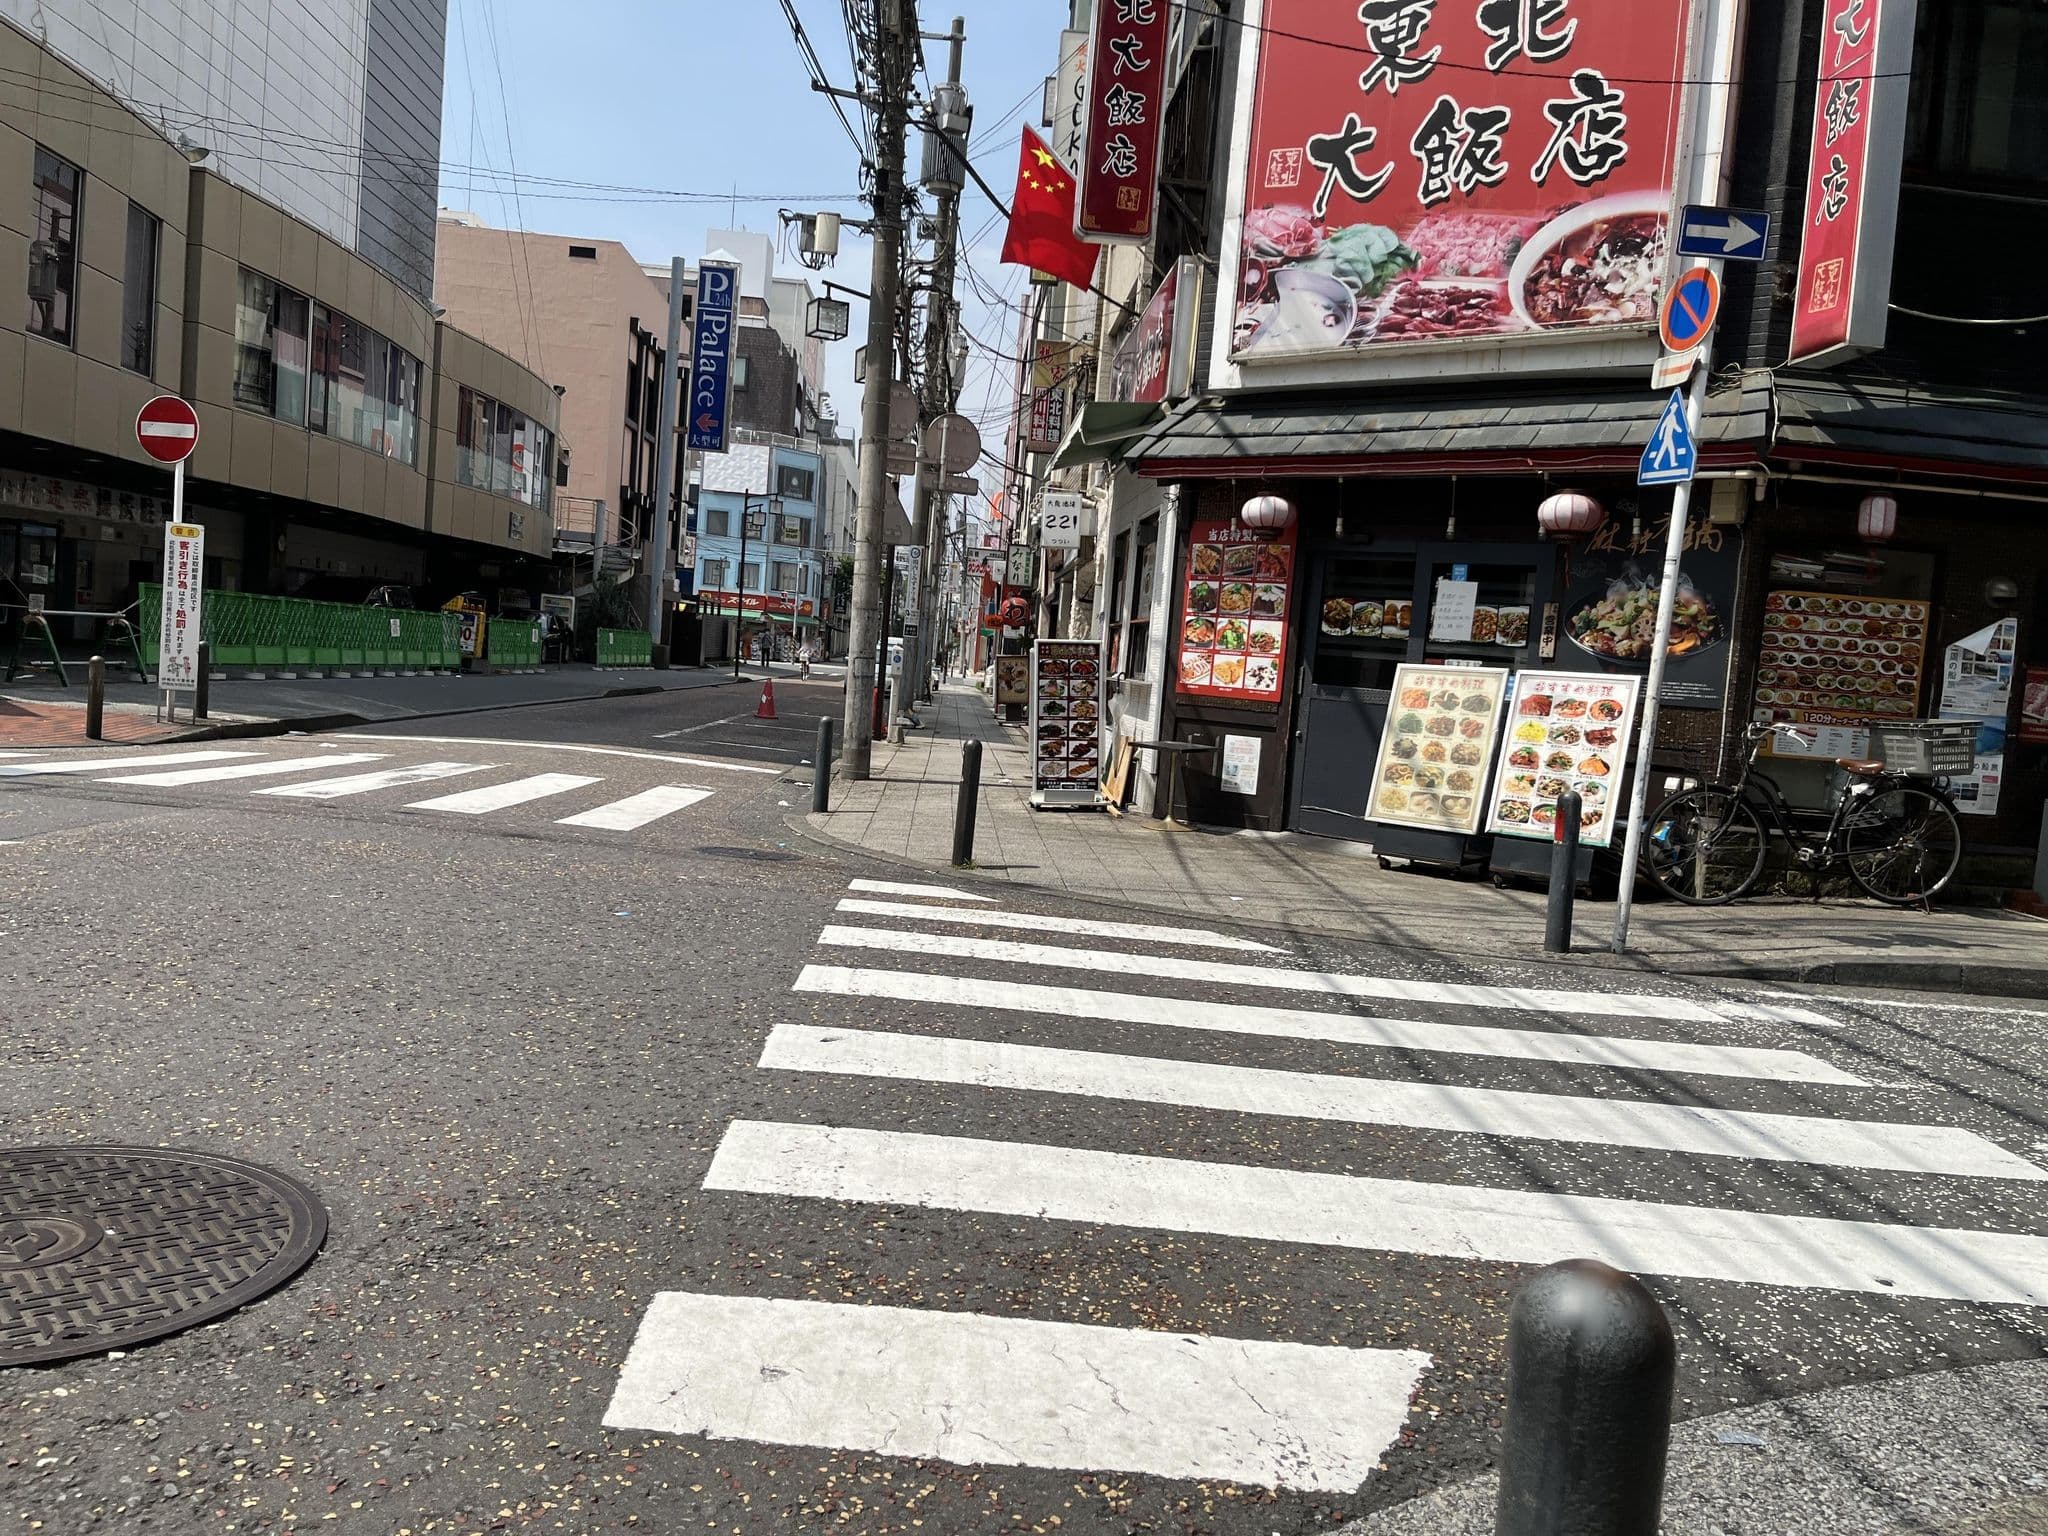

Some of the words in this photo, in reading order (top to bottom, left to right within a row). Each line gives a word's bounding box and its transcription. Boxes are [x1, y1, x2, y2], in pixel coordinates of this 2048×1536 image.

[1305, 68, 1628, 217] 大飯店
[701, 271, 729, 304] P
[698, 312, 728, 407] Palace
[691, 435, 720, 448] 大型可
[1031, 387, 1048, 442] 四川料理
[1047, 388, 1064, 443] 東北料理
[1045, 514, 1078, 530] 221
